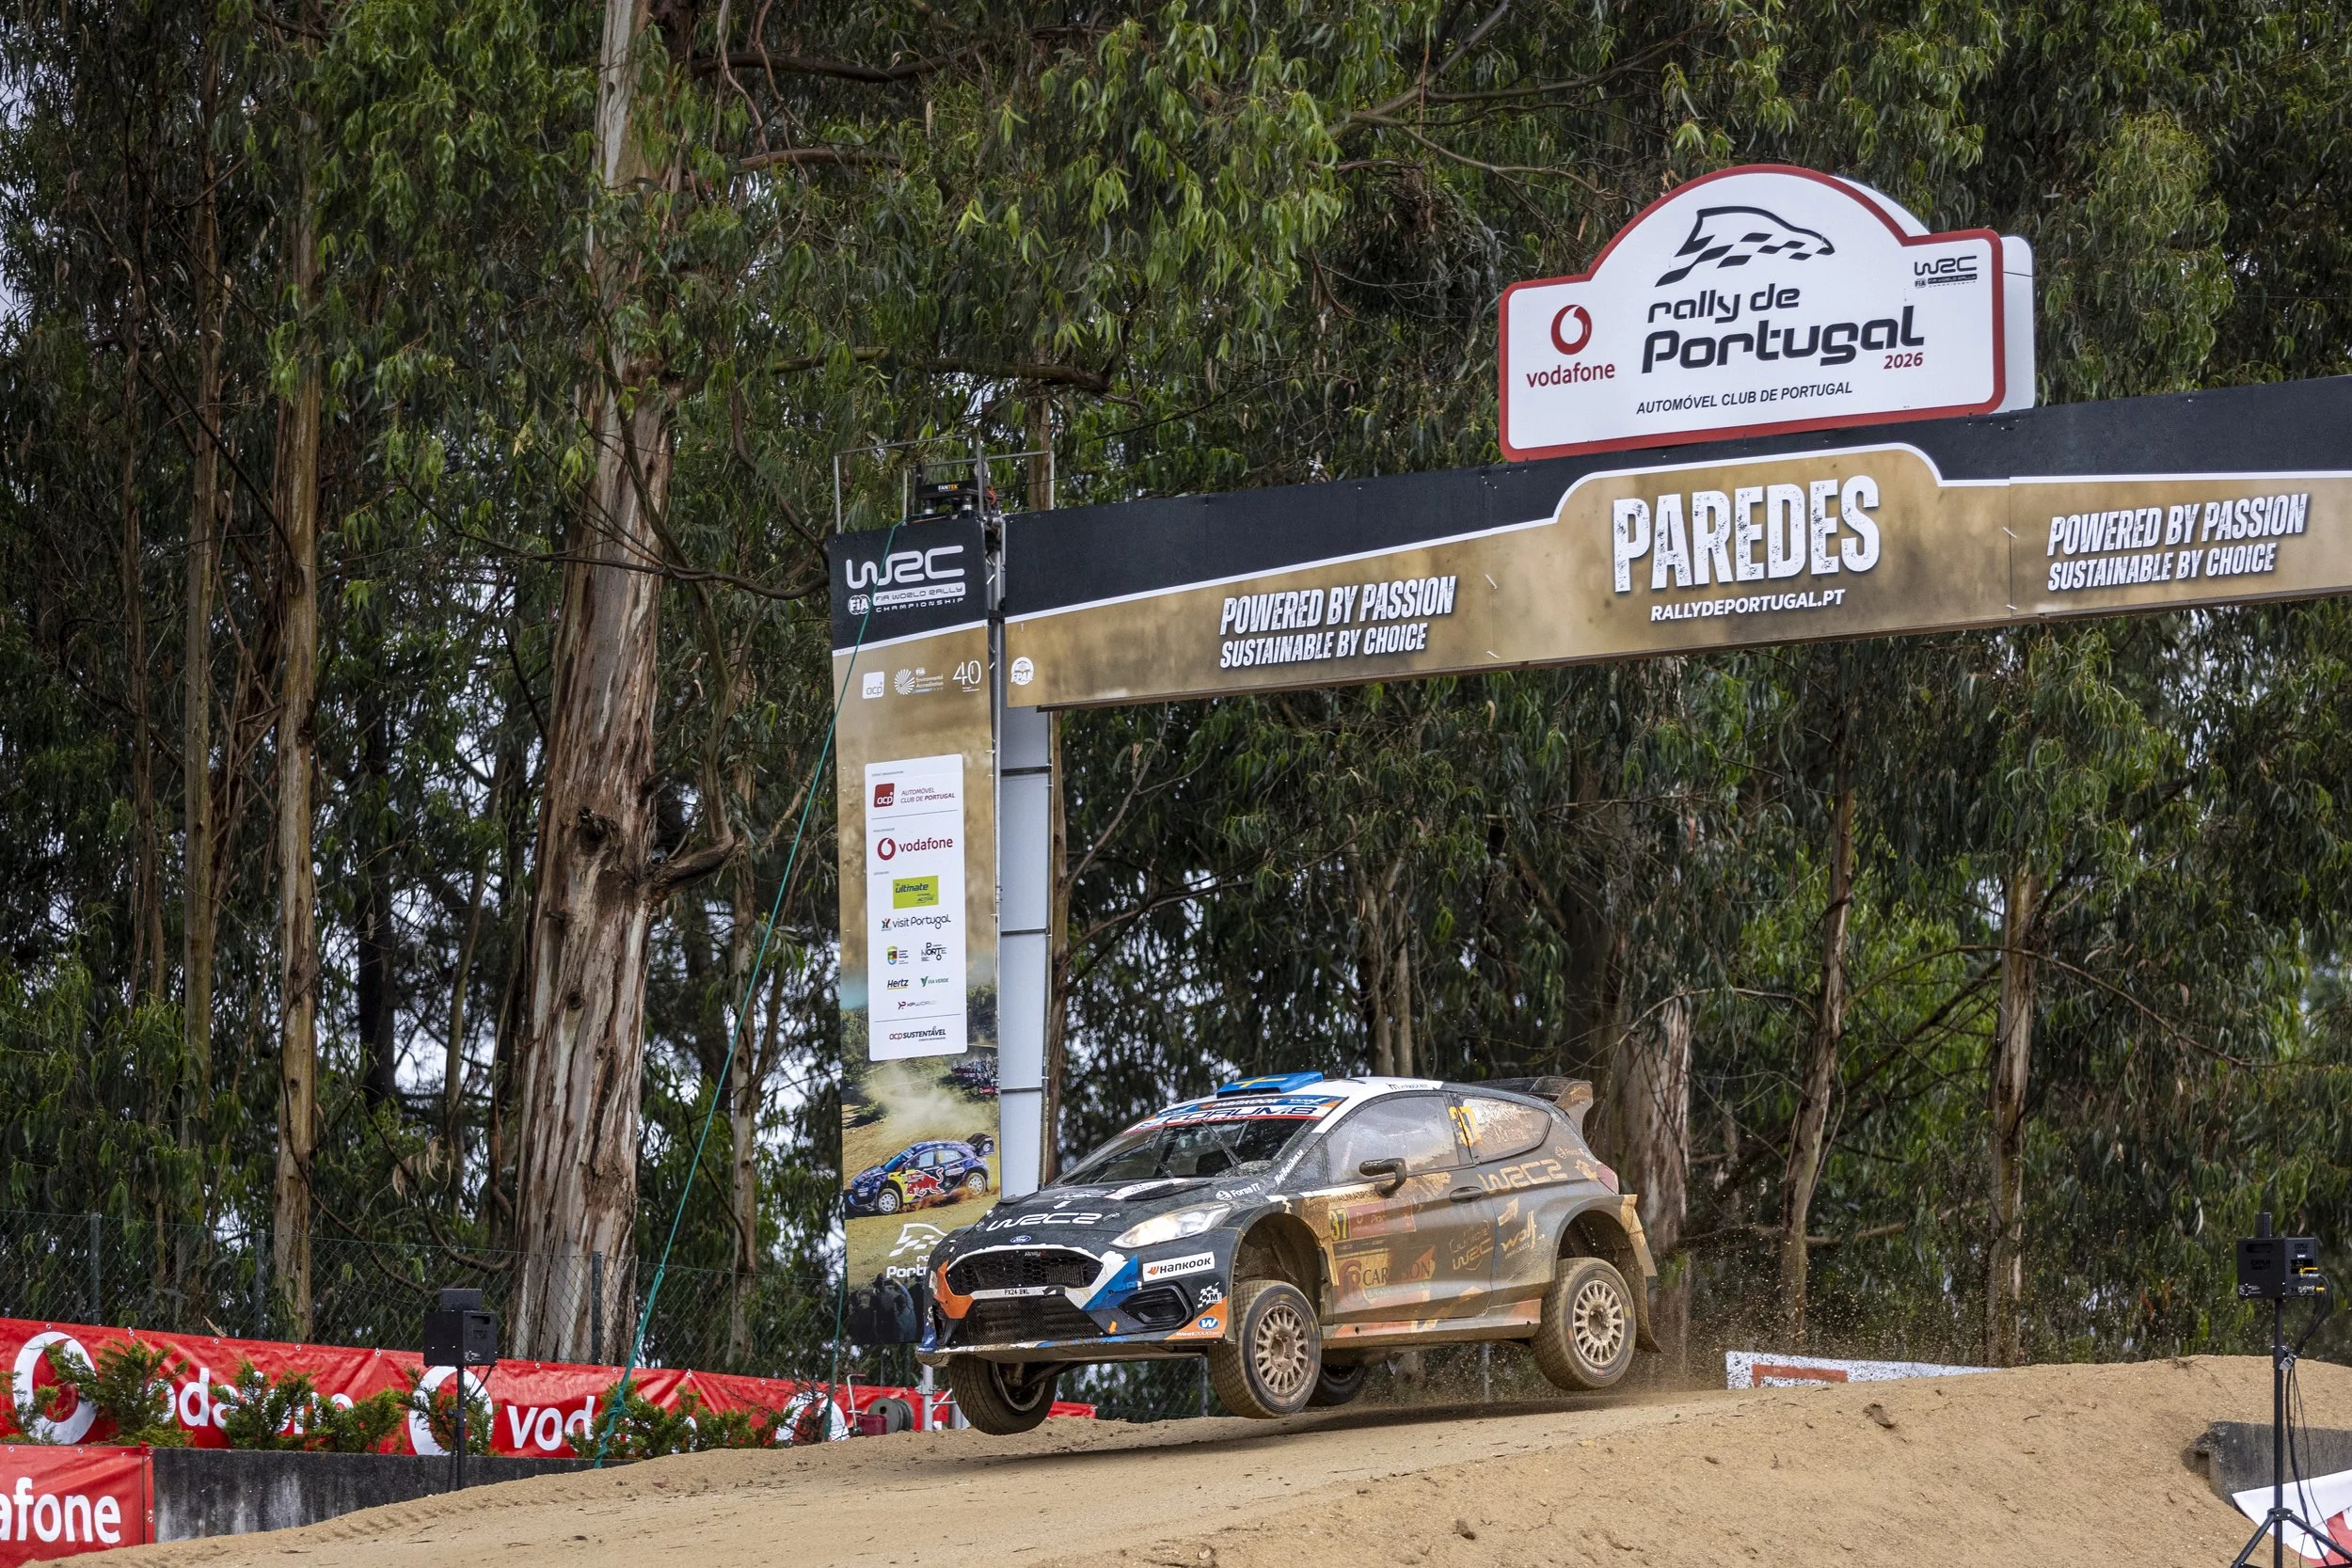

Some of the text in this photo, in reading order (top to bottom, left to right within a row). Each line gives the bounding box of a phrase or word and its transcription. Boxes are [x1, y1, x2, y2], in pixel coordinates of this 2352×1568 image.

[1914, 255, 1978, 276] WRC
[1647, 283, 1801, 324] rally de
[1642, 305, 1925, 374] Portugal
[1526, 359, 1615, 388] vodafone
[1883, 353, 1924, 370] 2026
[1636, 381, 1853, 415] AUTOMÓVEL CLUB DE PORTUGAL
[1613, 474, 1880, 593] PAREDES
[2046, 493, 2308, 557] POWERED BY PASSION
[846, 546, 965, 590] WRC
[2047, 542, 2277, 592] SUSTAINABLE BY CHOICE
[850, 598, 869, 611] FIA
[875, 597, 964, 612] CHAMPIONSHIP
[892, 590, 927, 600] WORLD
[929, 586, 963, 596] RALLY
[1219, 575, 1457, 636] POWERED BY PASSION
[1650, 589, 1846, 622] RALLYDEPORTUGAL.PT
[1219, 622, 1428, 669] SUSTAINABLE BY CHOICE
[952, 659, 982, 686] 40
[876, 795, 893, 805] acp
[901, 787, 935, 796] AUTOMÓVEL
[924, 792, 955, 801] PORTUGAL
[898, 837, 953, 852] vodafone
[893, 914, 951, 929] visit Portugal
[887, 978, 909, 989] Hertz
[986, 1212, 1103, 1232] WRC2
[1328, 1209, 1347, 1241] 37
